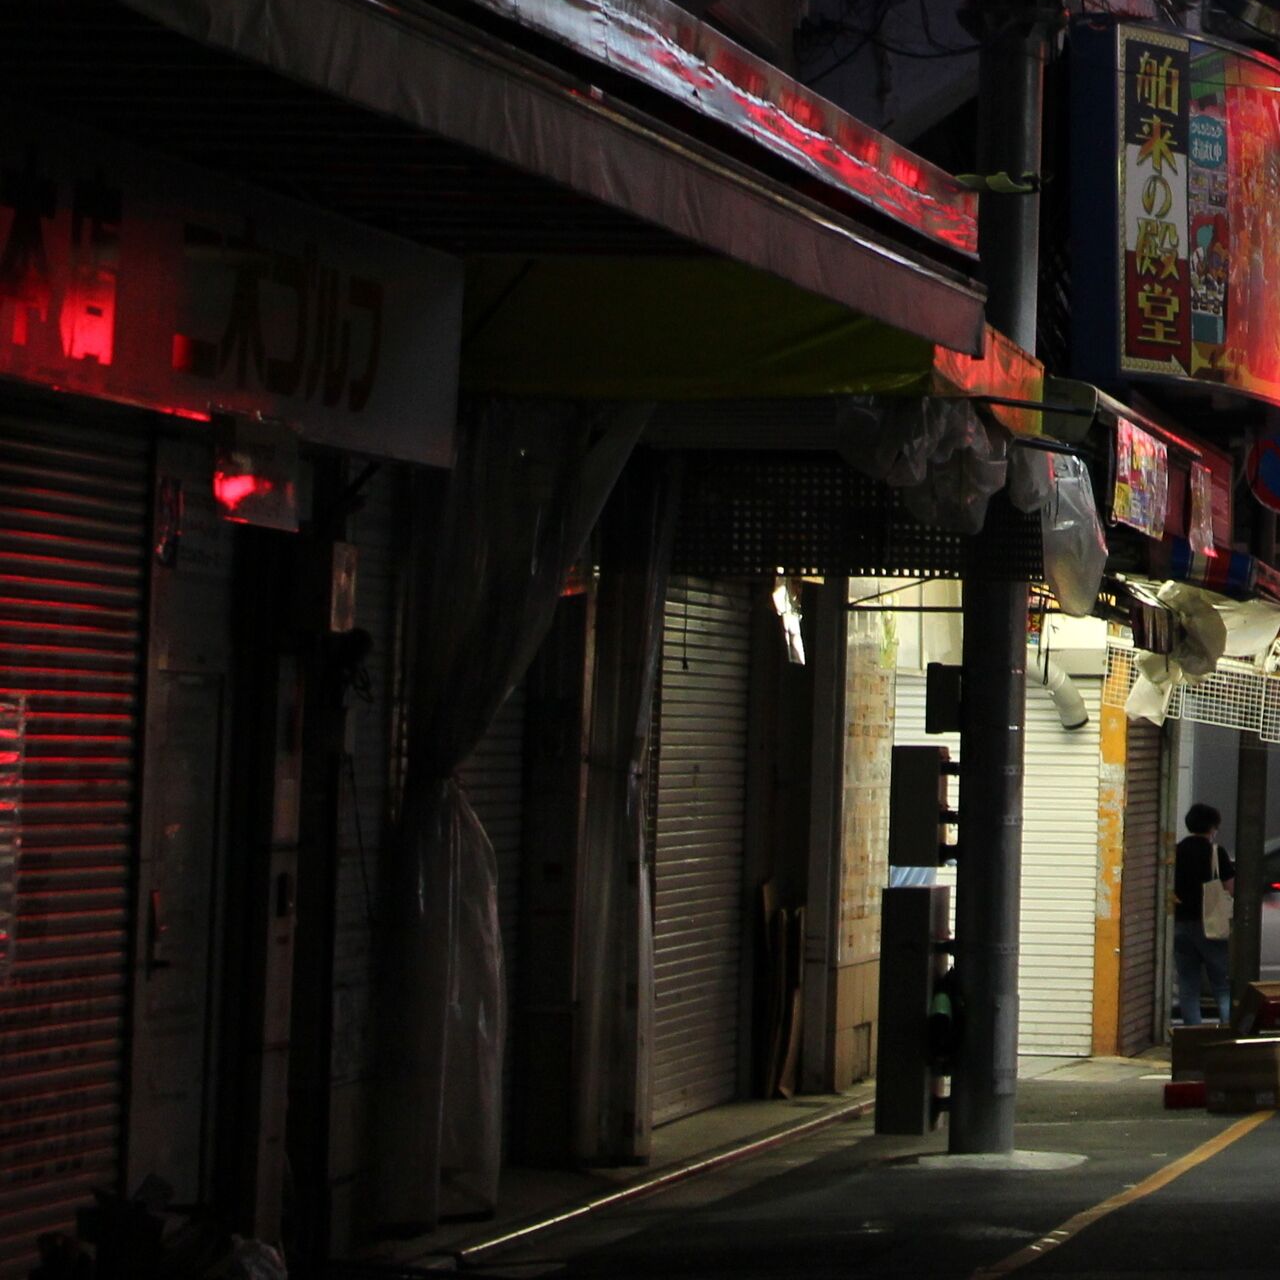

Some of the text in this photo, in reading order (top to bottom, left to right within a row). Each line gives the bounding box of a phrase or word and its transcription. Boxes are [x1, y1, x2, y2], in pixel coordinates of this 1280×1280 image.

[1135, 50, 1182, 347] 舶来の殿堂
